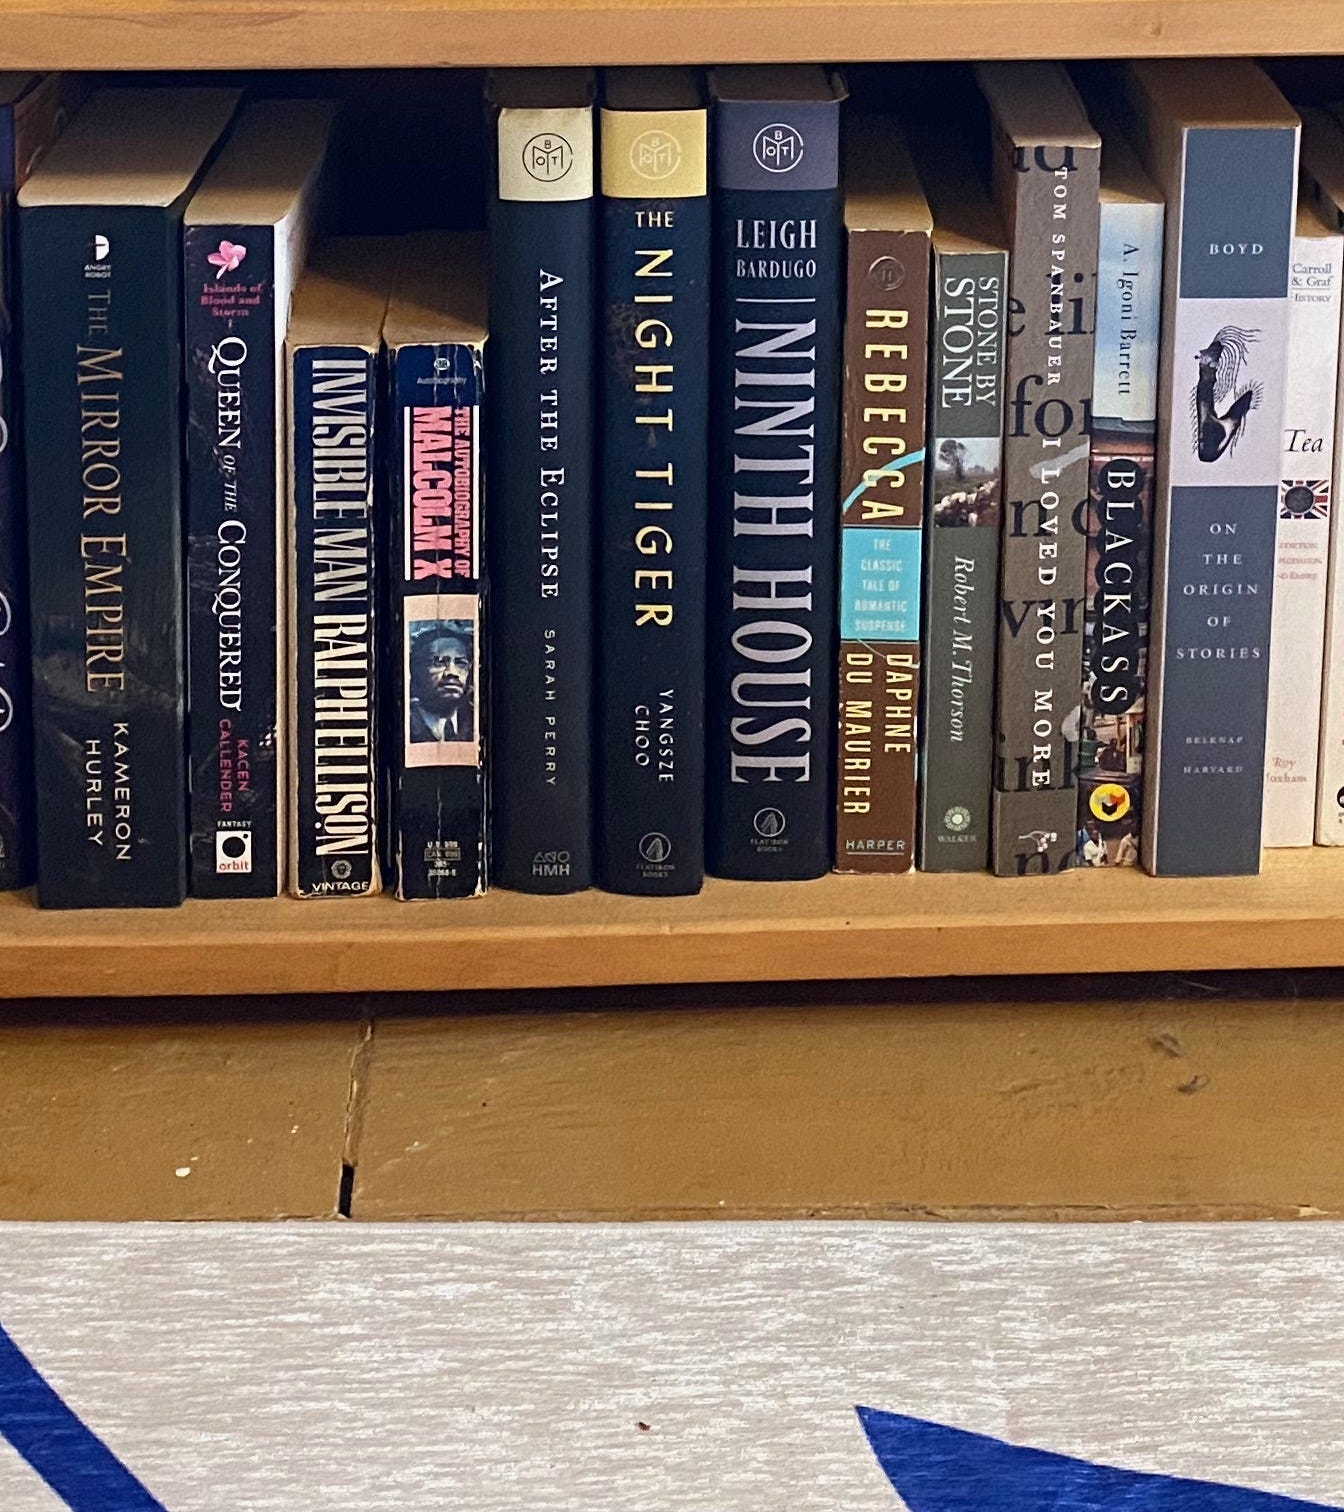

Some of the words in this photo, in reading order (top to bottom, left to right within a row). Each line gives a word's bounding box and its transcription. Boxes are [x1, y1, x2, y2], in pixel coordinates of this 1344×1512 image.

[635, 211, 674, 228] THE
[736, 219, 817, 249] LEIGH
[87, 289, 111, 336] THE
[634, 249, 673, 432] NIGHT
[941, 277, 975, 409] STONE
[976, 277, 999, 366] STONE
[76, 343, 122, 519] MIRROR
[207, 335, 248, 450] QUEEN
[734, 318, 816, 538] NINTH
[976, 375, 996, 406] BY
[223, 454, 237, 477] OF
[225, 481, 238, 511] THE
[634, 462, 673, 627] TIGER
[1101, 471, 1136, 703] BLACKASS
[1183, 583, 1258, 596] ORIGIN
[80, 533, 130, 692] EMPIRE
[211, 519, 247, 713] CONQUERED
[1176, 648, 1260, 659] STORIES
[730, 565, 813, 784] HOUSE
[218, 718, 234, 813] CALLENDER
[236, 738, 249, 793] KACEN
[634, 705, 650, 767] CHOO
[658, 688, 674, 783] YANGSZE
[84, 739, 105, 847] HURLEY
[112, 721, 132, 861] KAMERON
